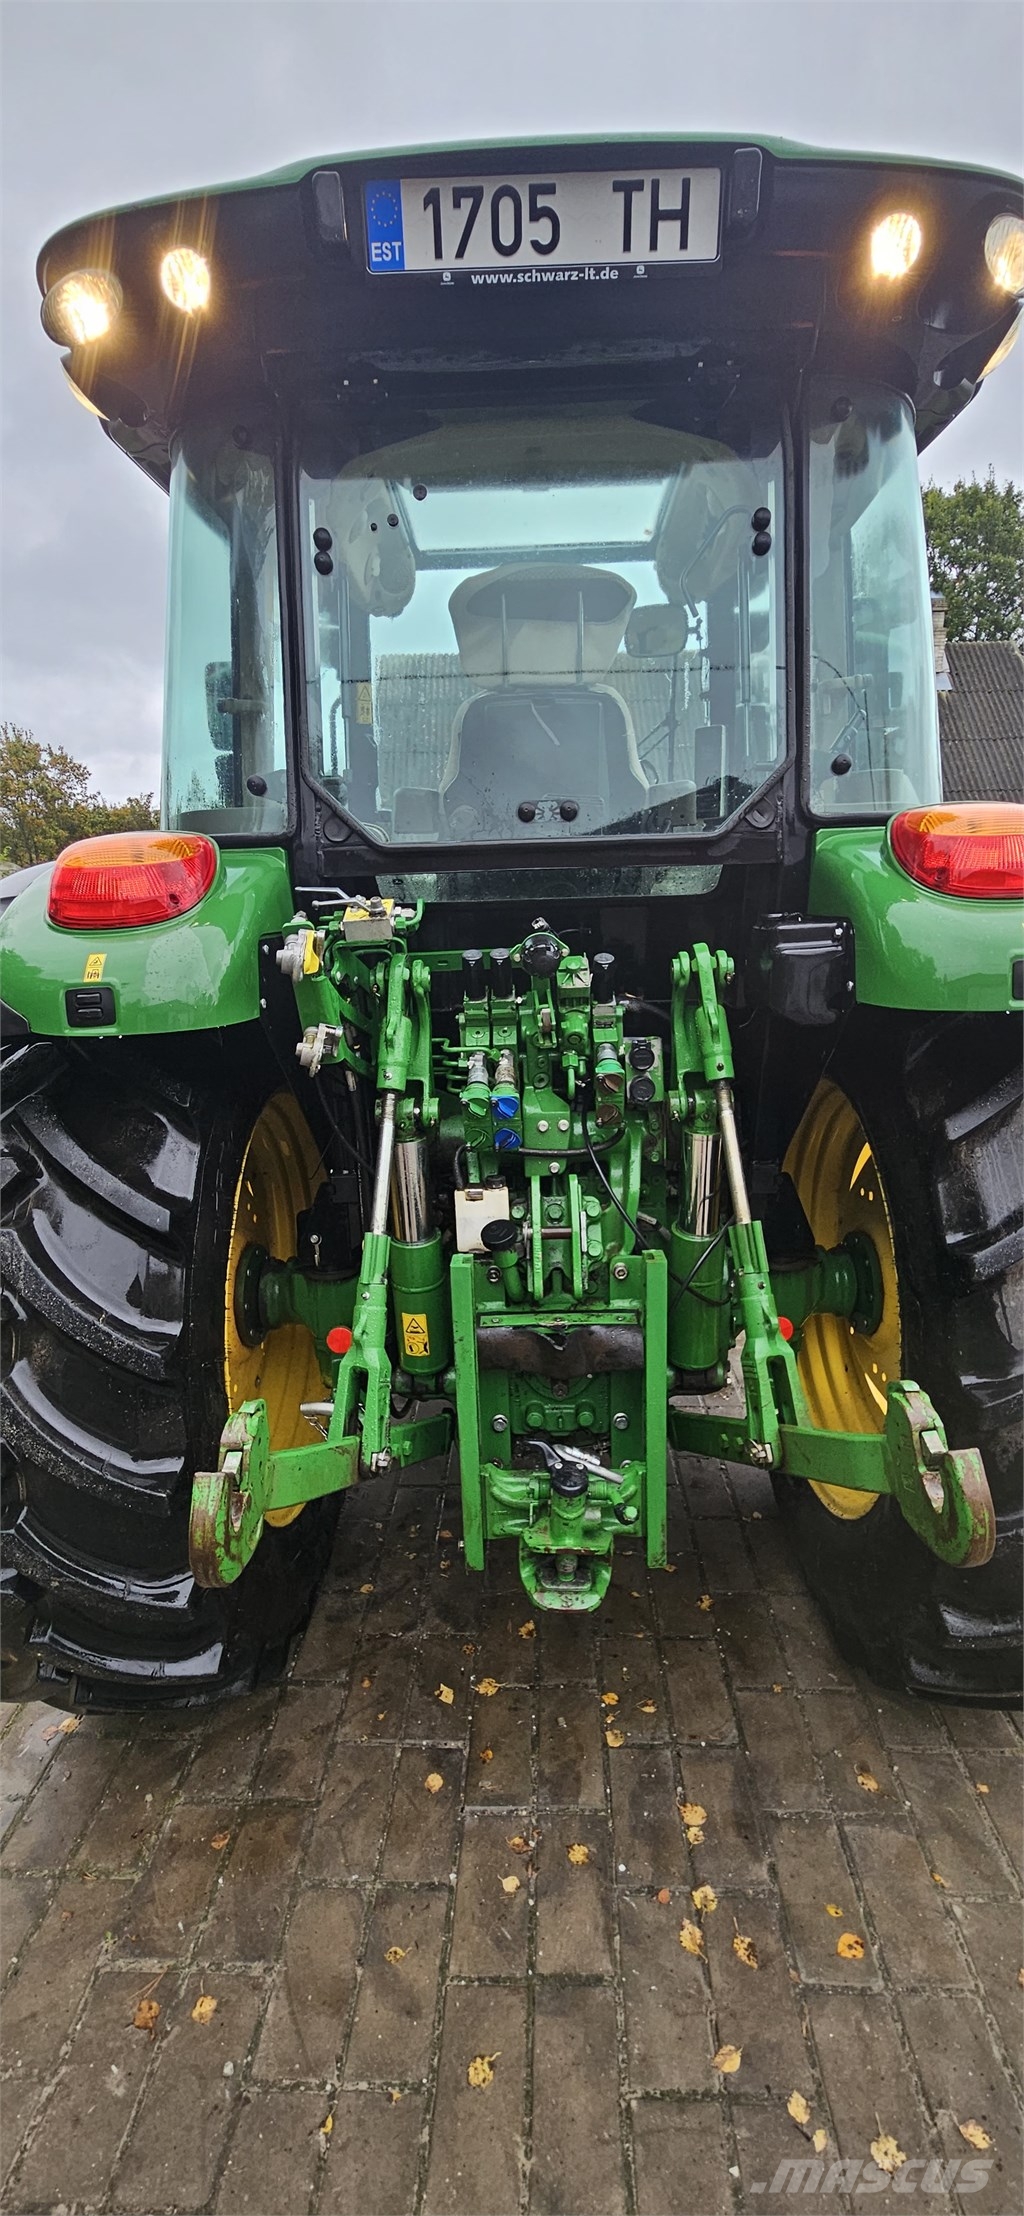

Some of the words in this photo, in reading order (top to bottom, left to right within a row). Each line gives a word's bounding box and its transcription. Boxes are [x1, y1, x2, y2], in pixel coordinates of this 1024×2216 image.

[422, 182, 561, 260] 1705
[612, 177, 691, 253] TH
[371, 241, 402, 262] EST
[471, 267, 619, 285] www.schwarz-lt.de
